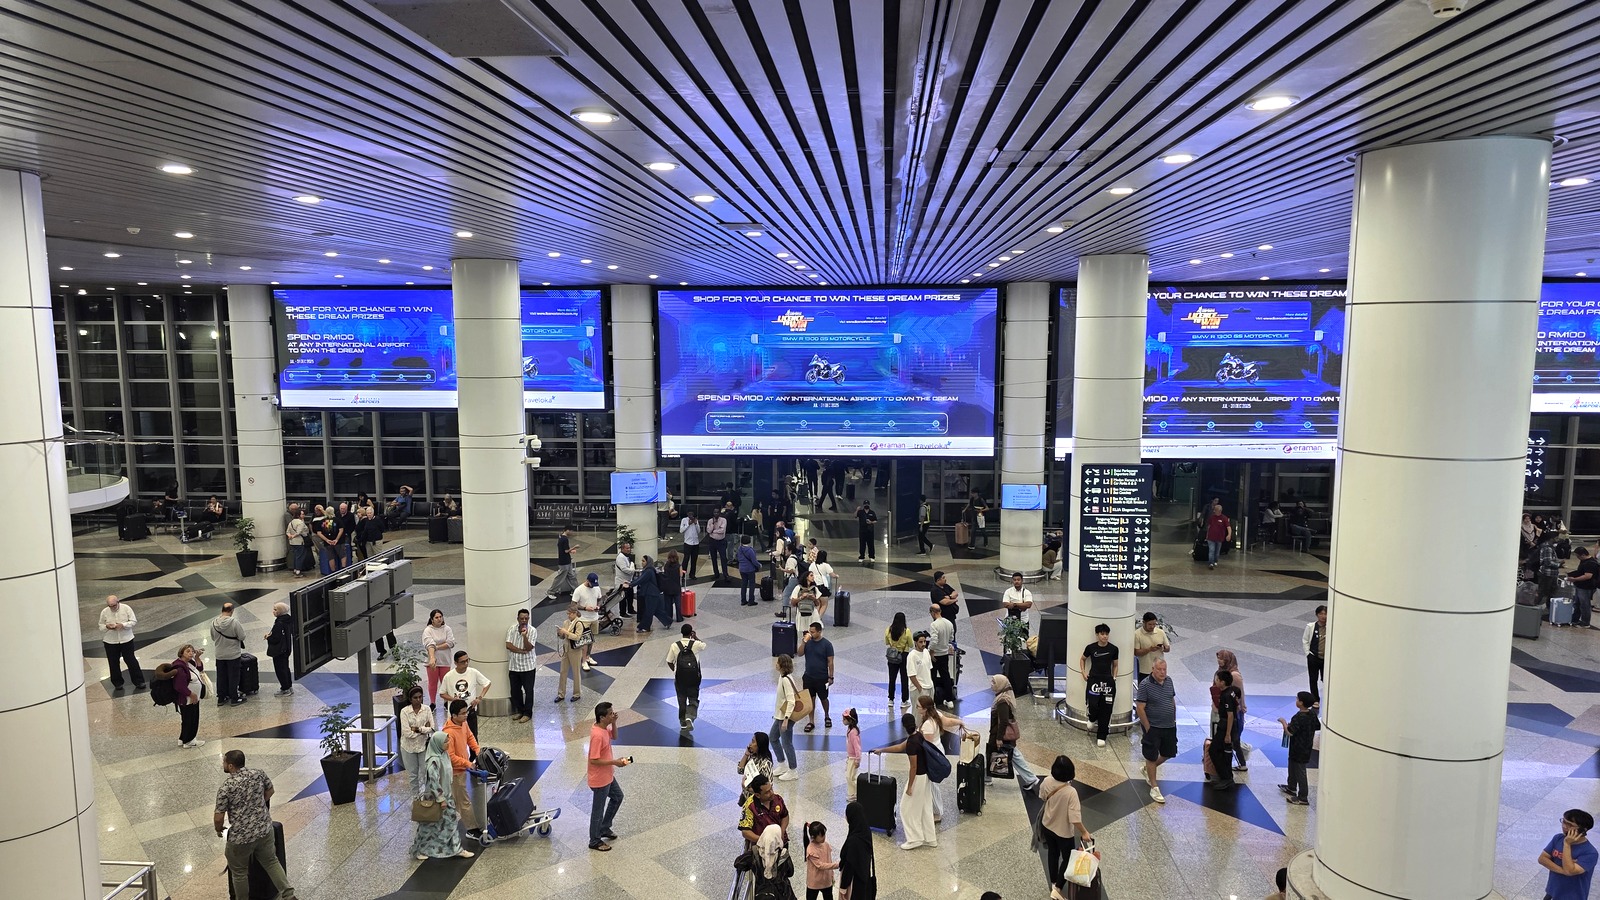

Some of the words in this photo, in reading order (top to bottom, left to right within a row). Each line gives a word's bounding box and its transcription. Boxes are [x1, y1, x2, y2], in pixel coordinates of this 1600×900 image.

[1153, 292, 1182, 300] YOUR
[1183, 291, 1227, 299] CHANCE
[1228, 291, 1244, 299] TO
[1309, 290, 1347, 298] DREAM
[287, 333, 321, 341] SPEND
